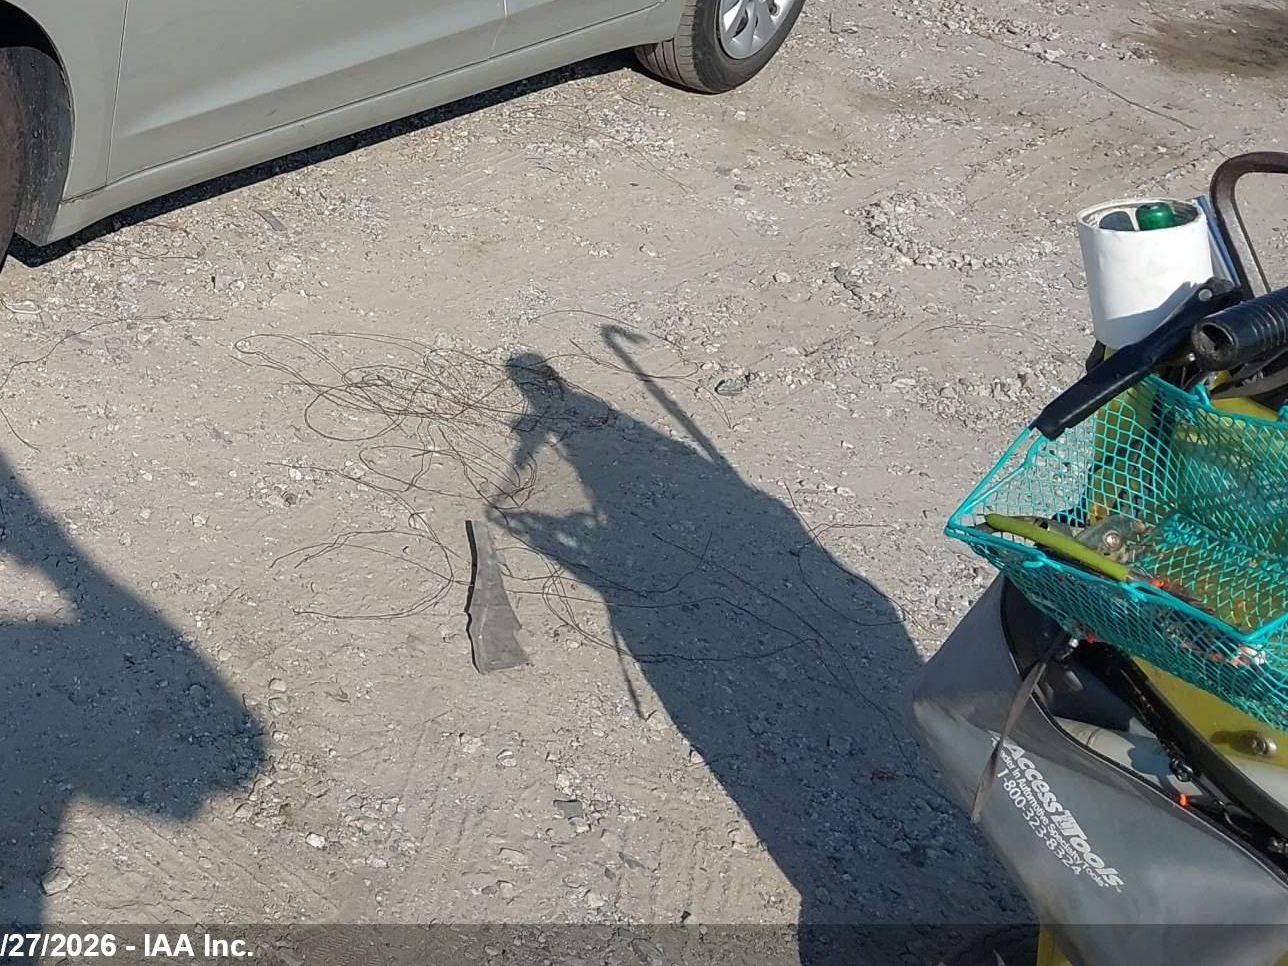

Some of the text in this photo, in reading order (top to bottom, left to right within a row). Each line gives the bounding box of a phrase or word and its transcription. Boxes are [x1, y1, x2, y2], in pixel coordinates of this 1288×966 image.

[997, 768, 1082, 875] 1-800-323-8324
[1002, 736, 1124, 886] Access Tools
[1017, 778, 1049, 825] Automotive
[1048, 823, 1083, 865] Specialty
